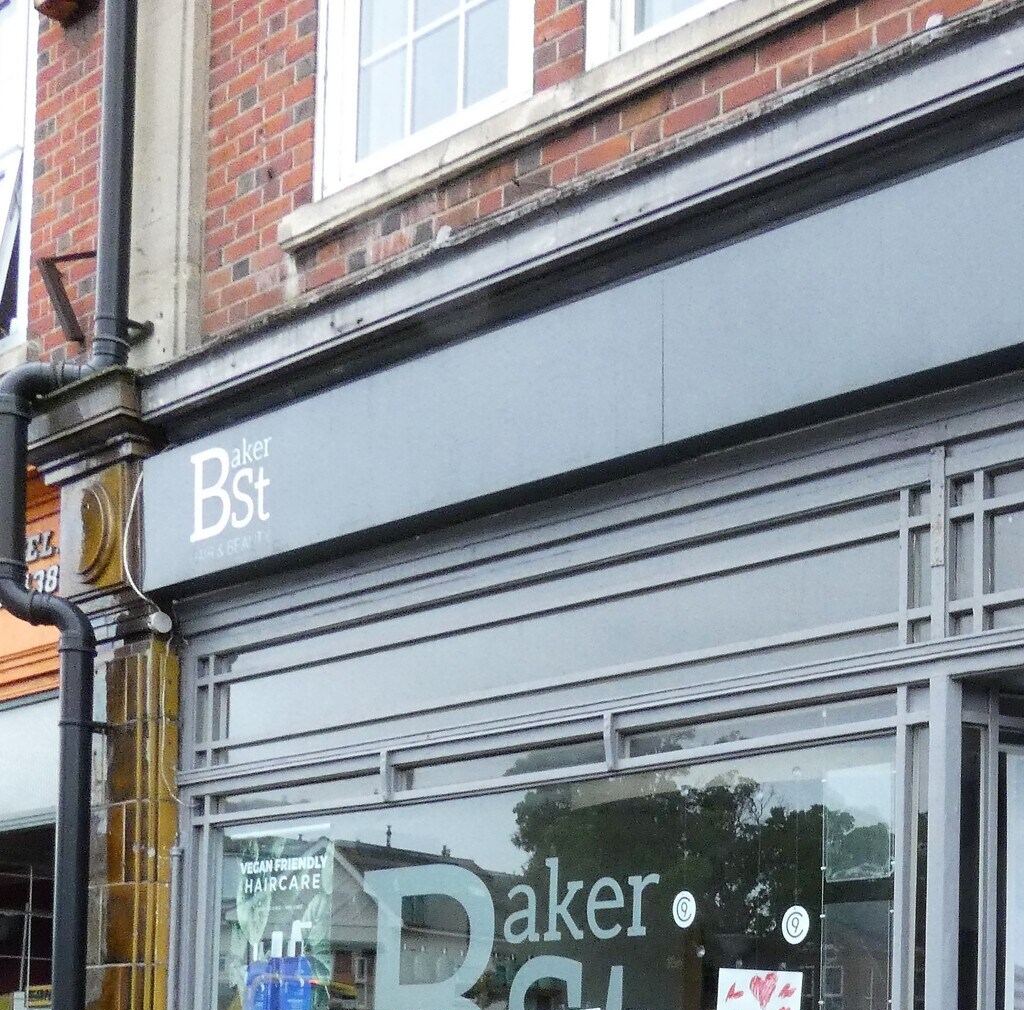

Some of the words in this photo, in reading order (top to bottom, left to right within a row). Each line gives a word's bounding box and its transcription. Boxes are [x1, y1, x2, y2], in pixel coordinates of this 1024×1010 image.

[240, 859, 273, 875] VEGAN
[274, 855, 328, 871] FRIENDLY
[244, 873, 321, 894] HAIRCARE
